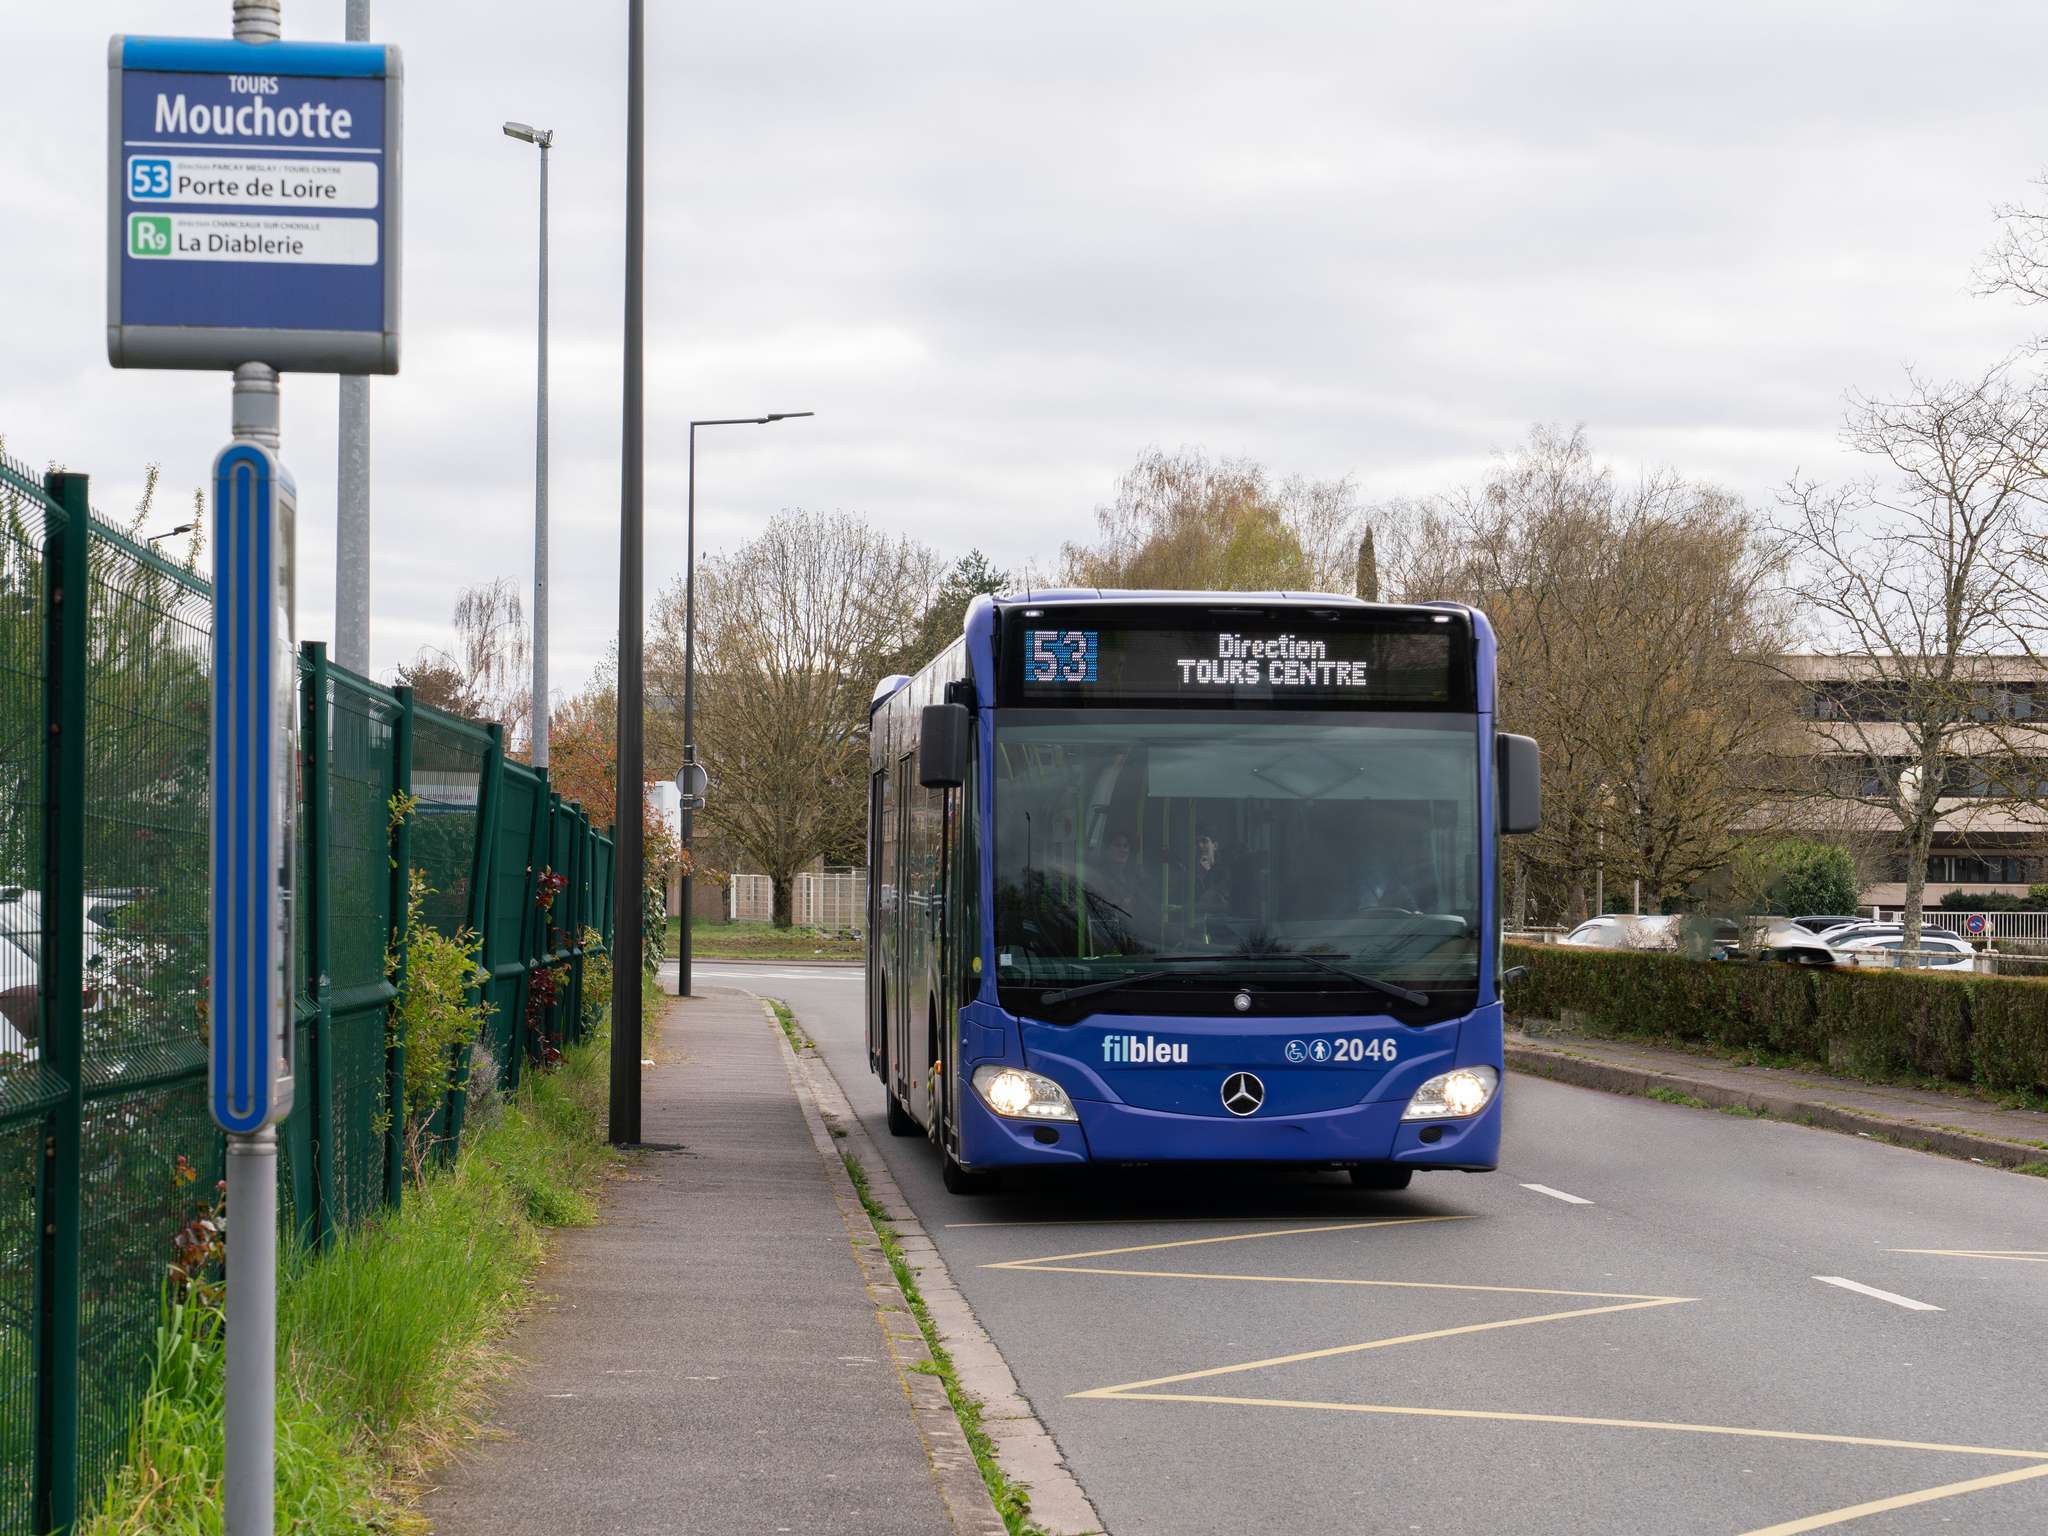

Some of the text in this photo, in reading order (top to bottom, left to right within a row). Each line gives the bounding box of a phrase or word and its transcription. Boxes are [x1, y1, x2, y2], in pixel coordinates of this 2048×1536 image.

[228, 75, 279, 95] TOURS
[154, 93, 353, 139] Mouchotte
[133, 164, 169, 194] 53
[178, 176, 337, 199] Porte de Loire
[137, 222, 167, 250] R9
[178, 232, 304, 254] La Diablerie
[1033, 631, 1087, 681] 53
[1219, 633, 1326, 658] Direction
[1178, 659, 1368, 686] TOURS CENTRE
[1102, 1035, 1188, 1063] filbleu
[1334, 1038, 1398, 1062] 2046
